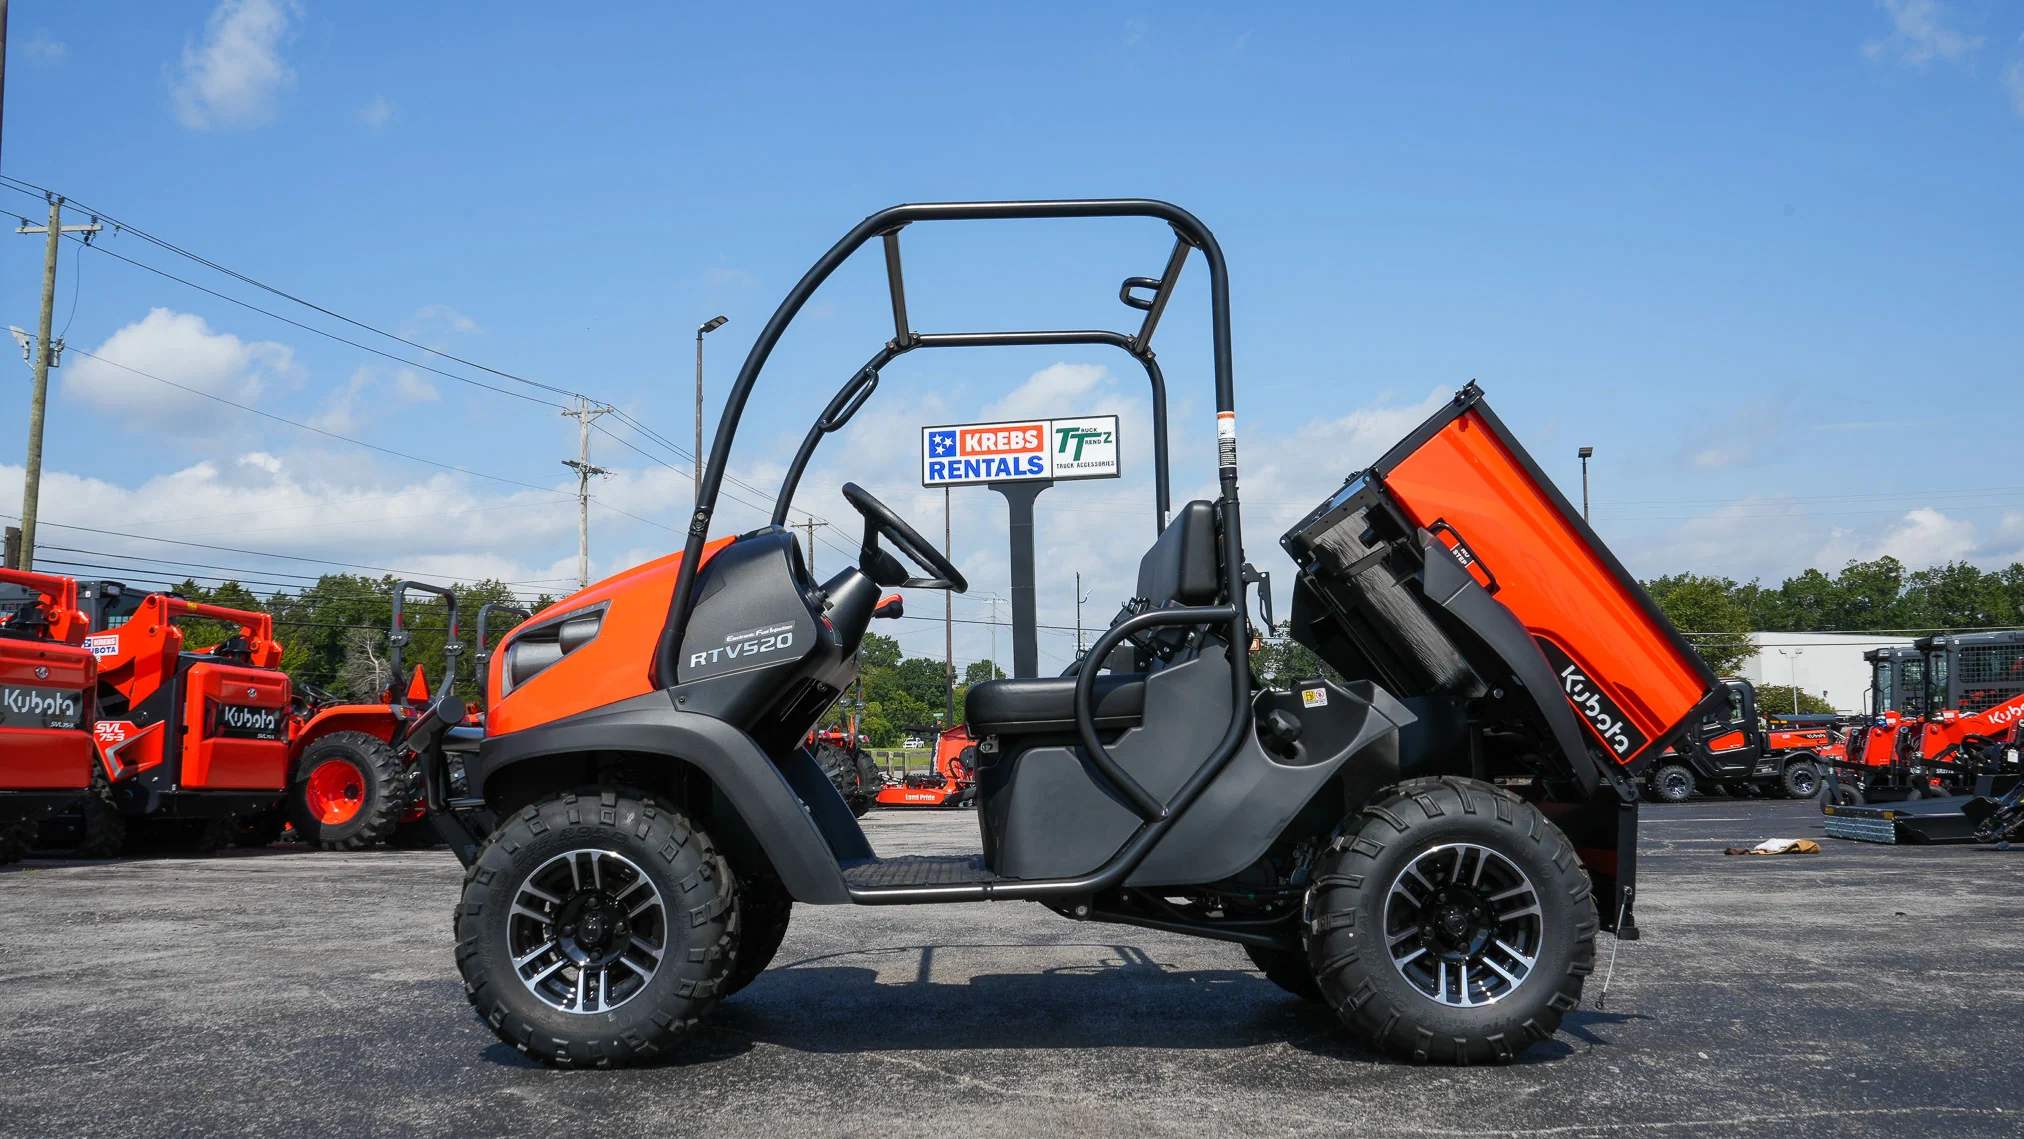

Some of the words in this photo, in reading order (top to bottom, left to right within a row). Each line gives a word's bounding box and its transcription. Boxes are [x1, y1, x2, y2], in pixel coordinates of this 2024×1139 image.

[965, 429, 1039, 452] KREBS
[929, 455, 1044, 481] RENTALS
[1452, 549, 1468, 565] STEP
[690, 632, 793, 668] RTV520
[4, 688, 74, 716] Kubota
[1560, 664, 1629, 754] Kubota
[95, 723, 125, 733] SVL
[225, 706, 275, 729] Kubota
[99, 733, 125, 741] 75-3
